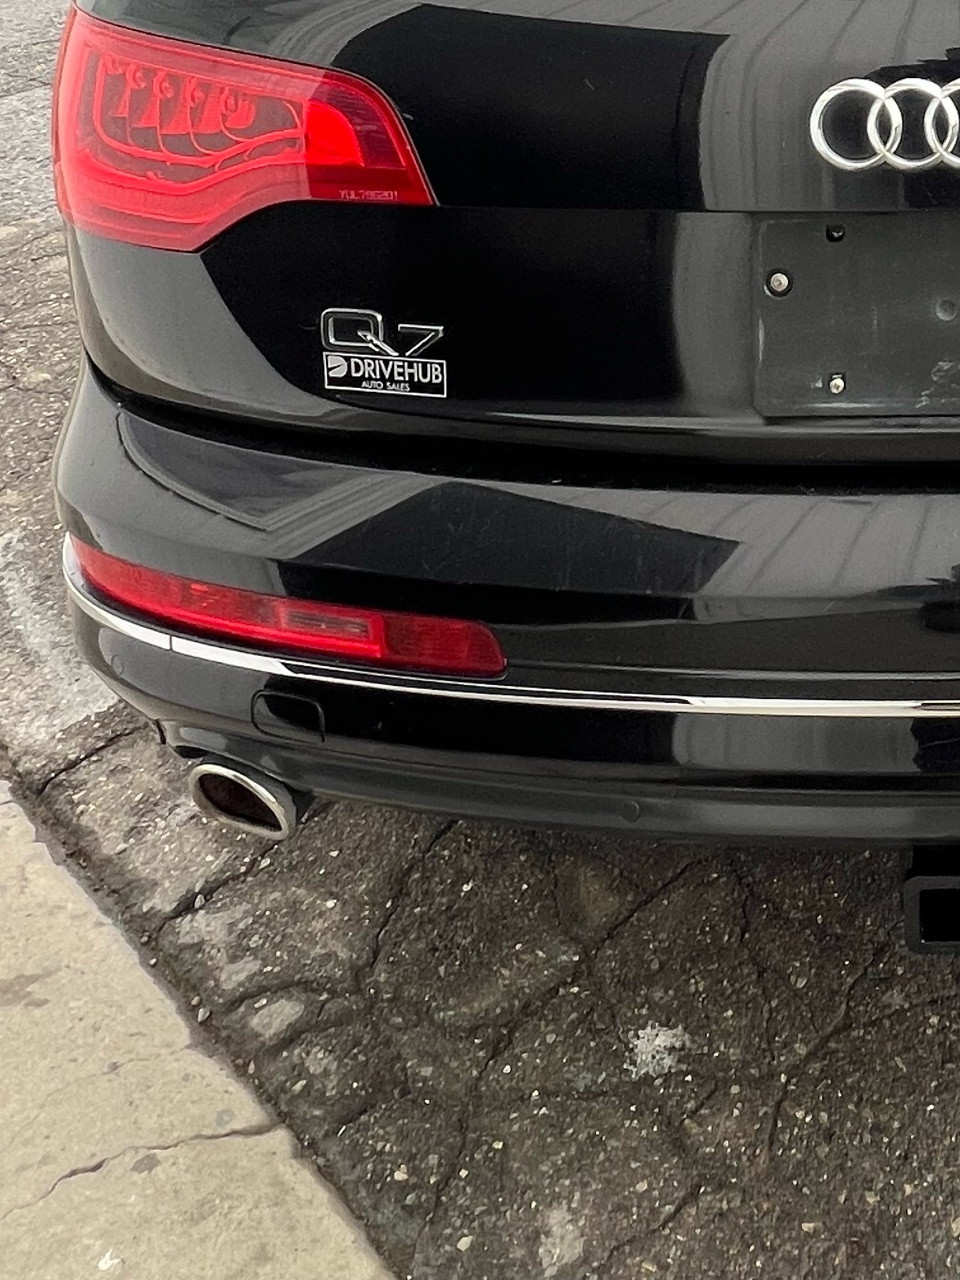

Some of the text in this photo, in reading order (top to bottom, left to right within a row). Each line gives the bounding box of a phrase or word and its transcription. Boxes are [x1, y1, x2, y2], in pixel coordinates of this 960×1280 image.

[320, 307, 445, 357] Q7
[350, 357, 443, 384] DRIVEHUB
[361, 380, 411, 392] AUTO SALES
